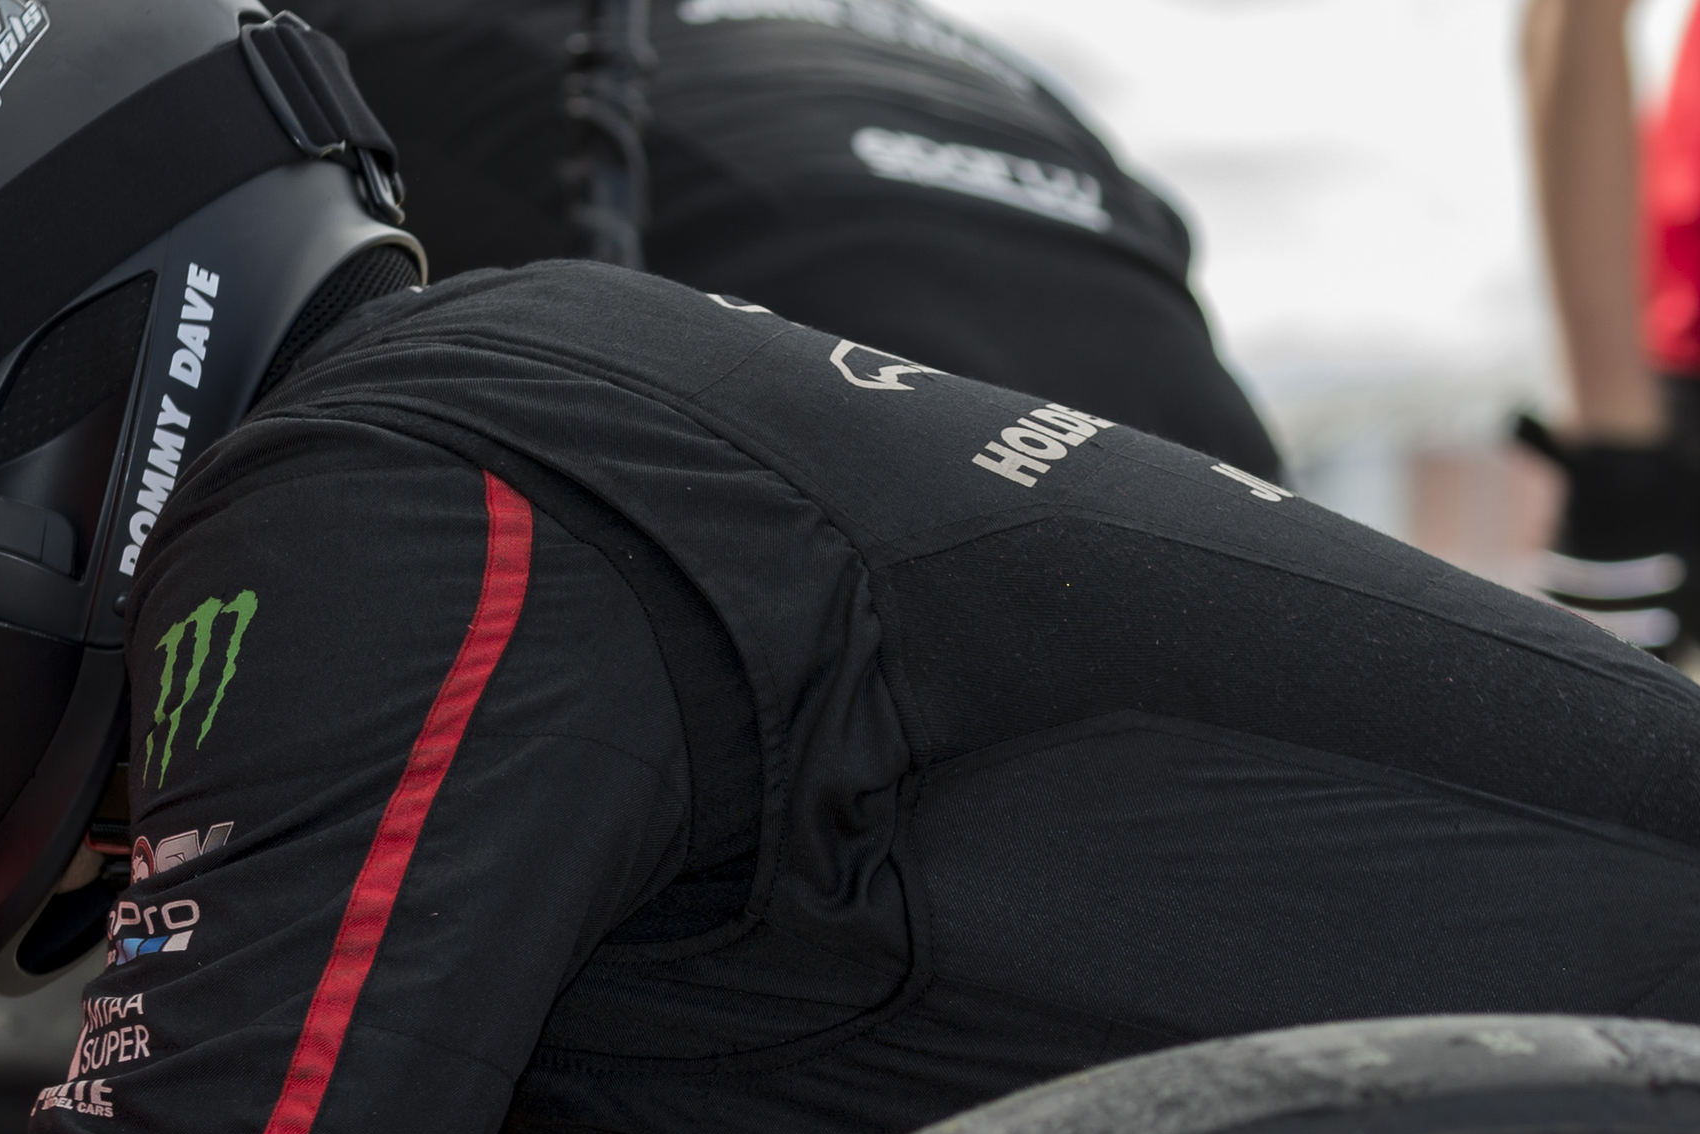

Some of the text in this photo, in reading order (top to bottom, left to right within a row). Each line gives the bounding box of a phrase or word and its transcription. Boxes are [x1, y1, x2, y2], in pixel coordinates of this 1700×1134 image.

[169, 262, 221, 389] DAVE
[971, 402, 1118, 488] HOLDE
[81, 1023, 150, 1074] SUPER
[76, 1102, 114, 1118] CARS
